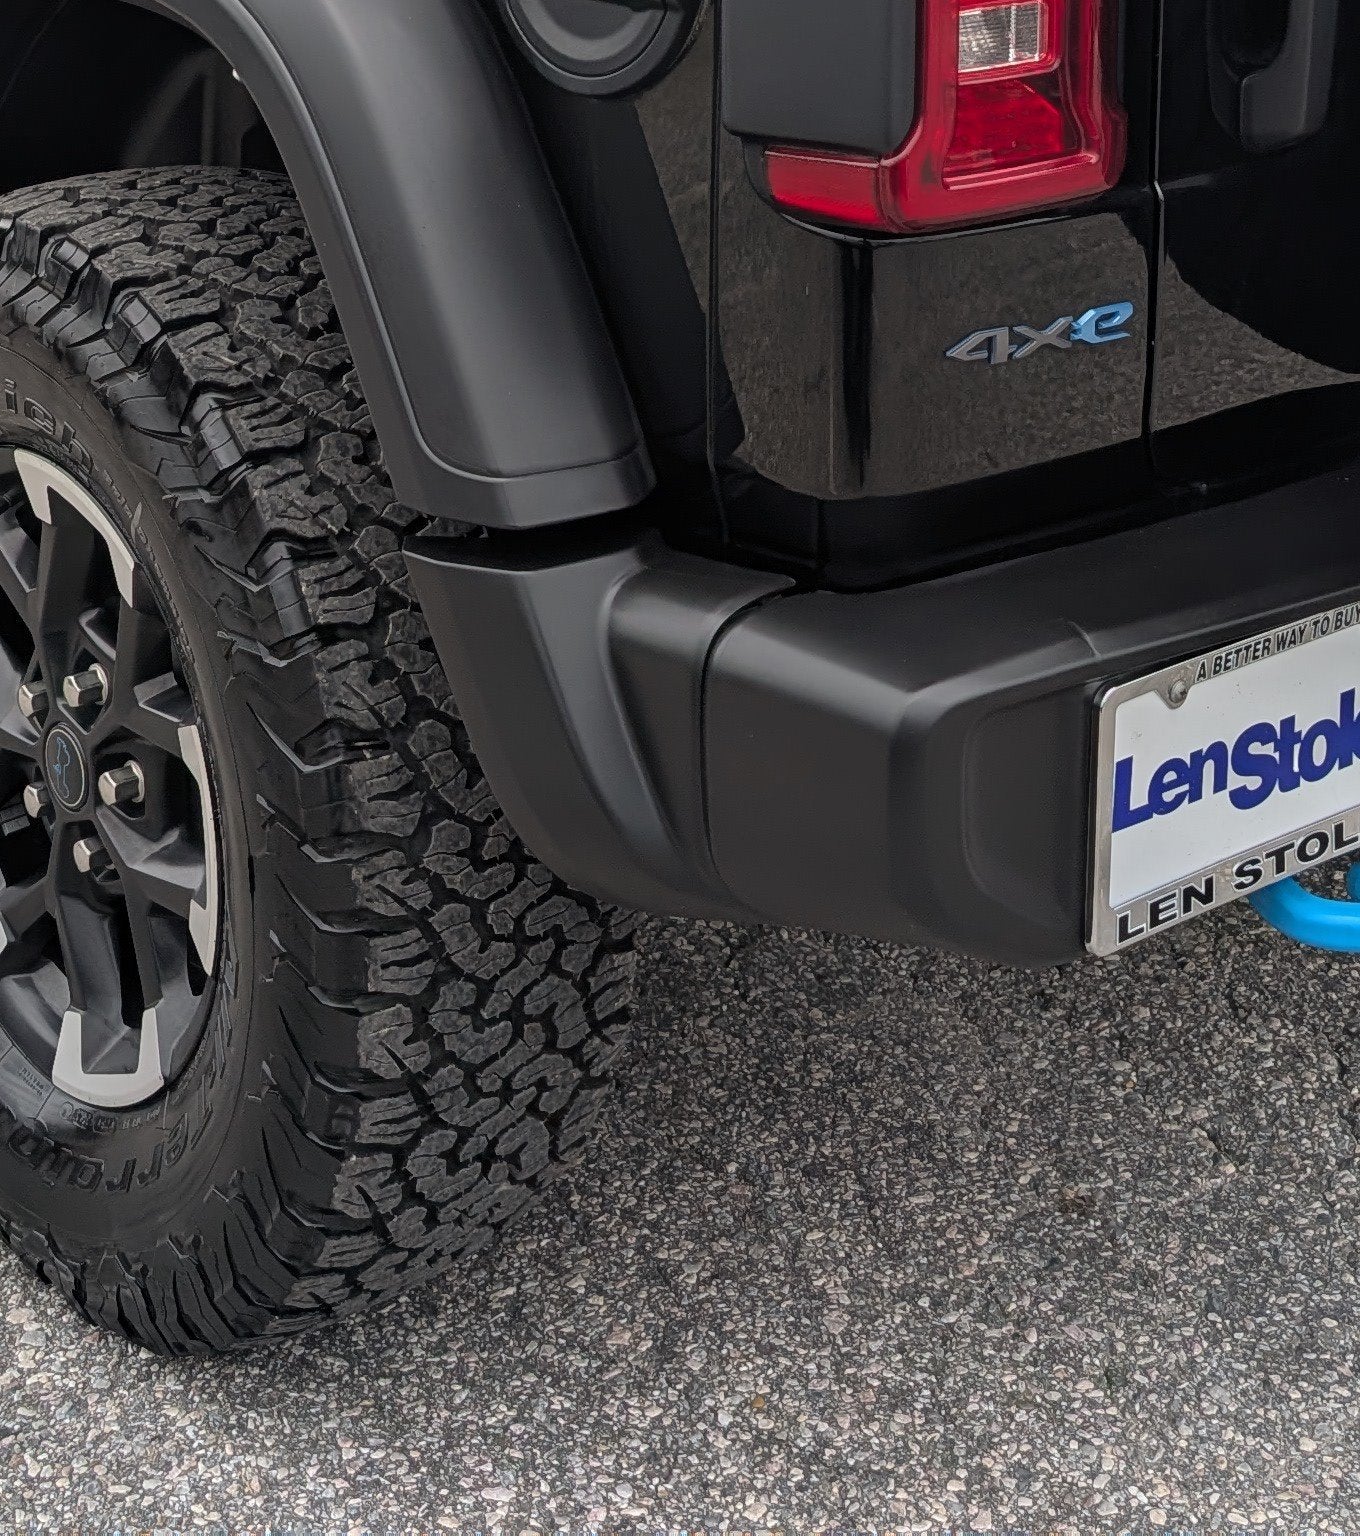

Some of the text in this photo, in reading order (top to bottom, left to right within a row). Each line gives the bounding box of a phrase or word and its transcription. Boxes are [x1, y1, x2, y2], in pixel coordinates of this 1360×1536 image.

[944, 300, 1135, 365] 4xe
[1195, 659, 1208, 684] A
[1212, 636, 1271, 676] BETTER
[1274, 624, 1308, 653] WAY
[1311, 614, 1331, 637] TO
[1116, 876, 1216, 946] LEN
